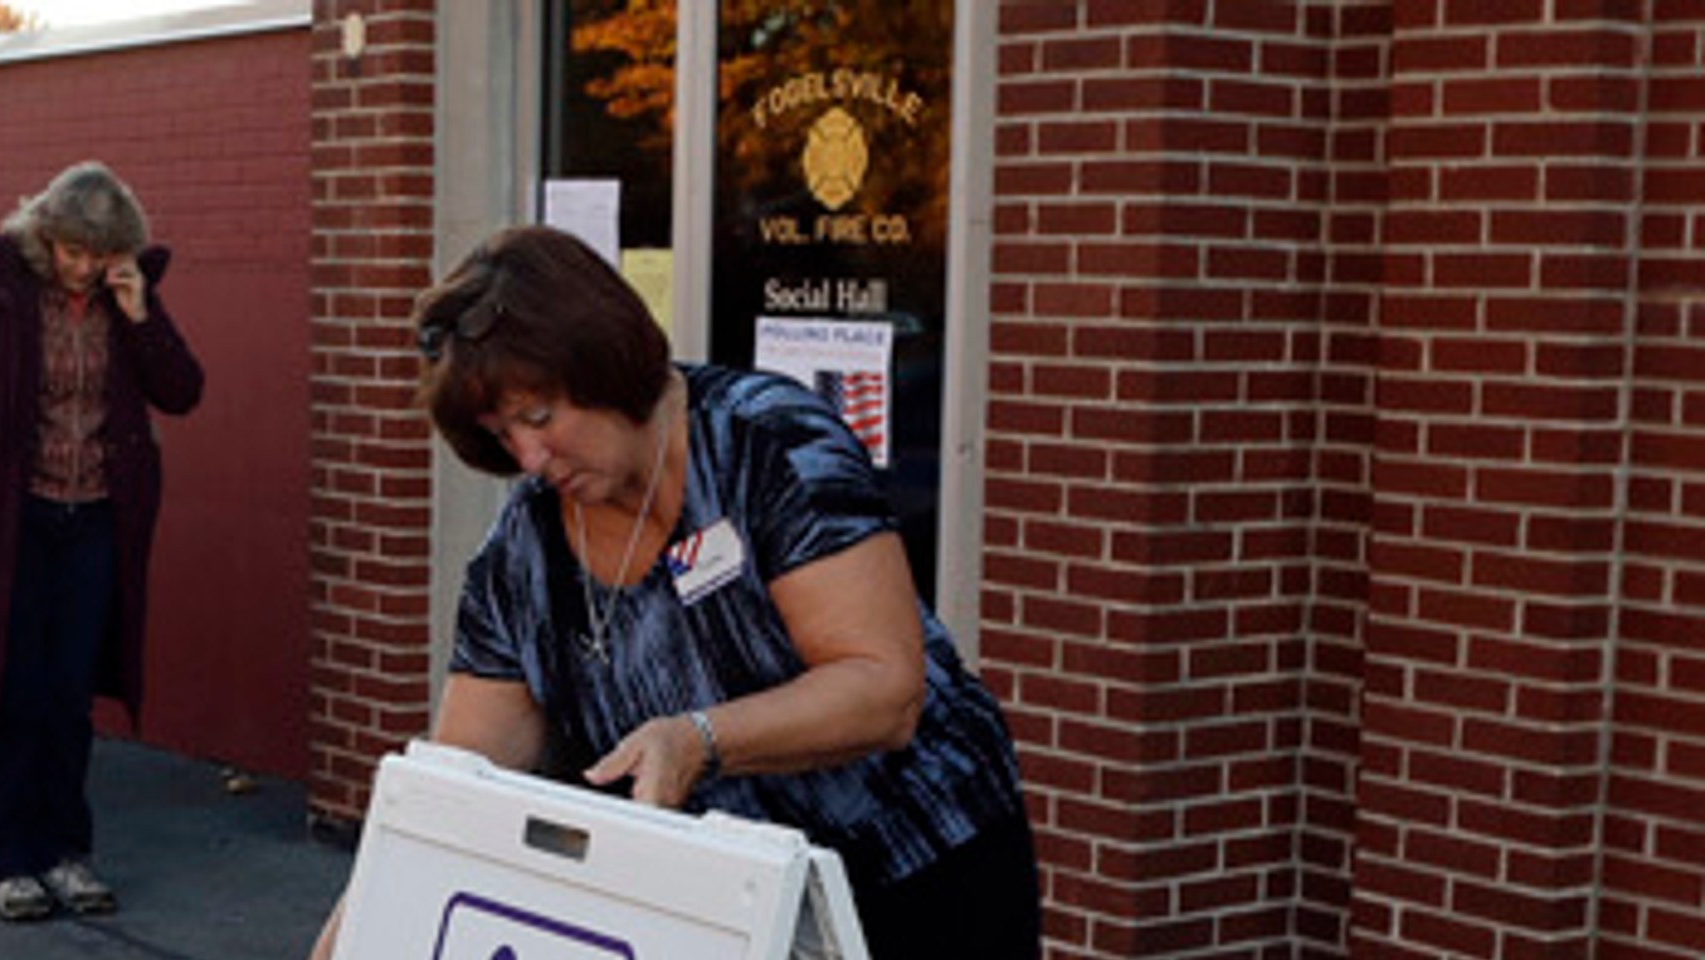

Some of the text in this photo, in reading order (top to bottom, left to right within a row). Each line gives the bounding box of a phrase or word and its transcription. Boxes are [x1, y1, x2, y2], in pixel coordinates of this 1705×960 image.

[753, 69, 923, 128] FOGELSVILLE
[815, 216, 868, 243] FIRE
[764, 278, 887, 312] Social Hall
